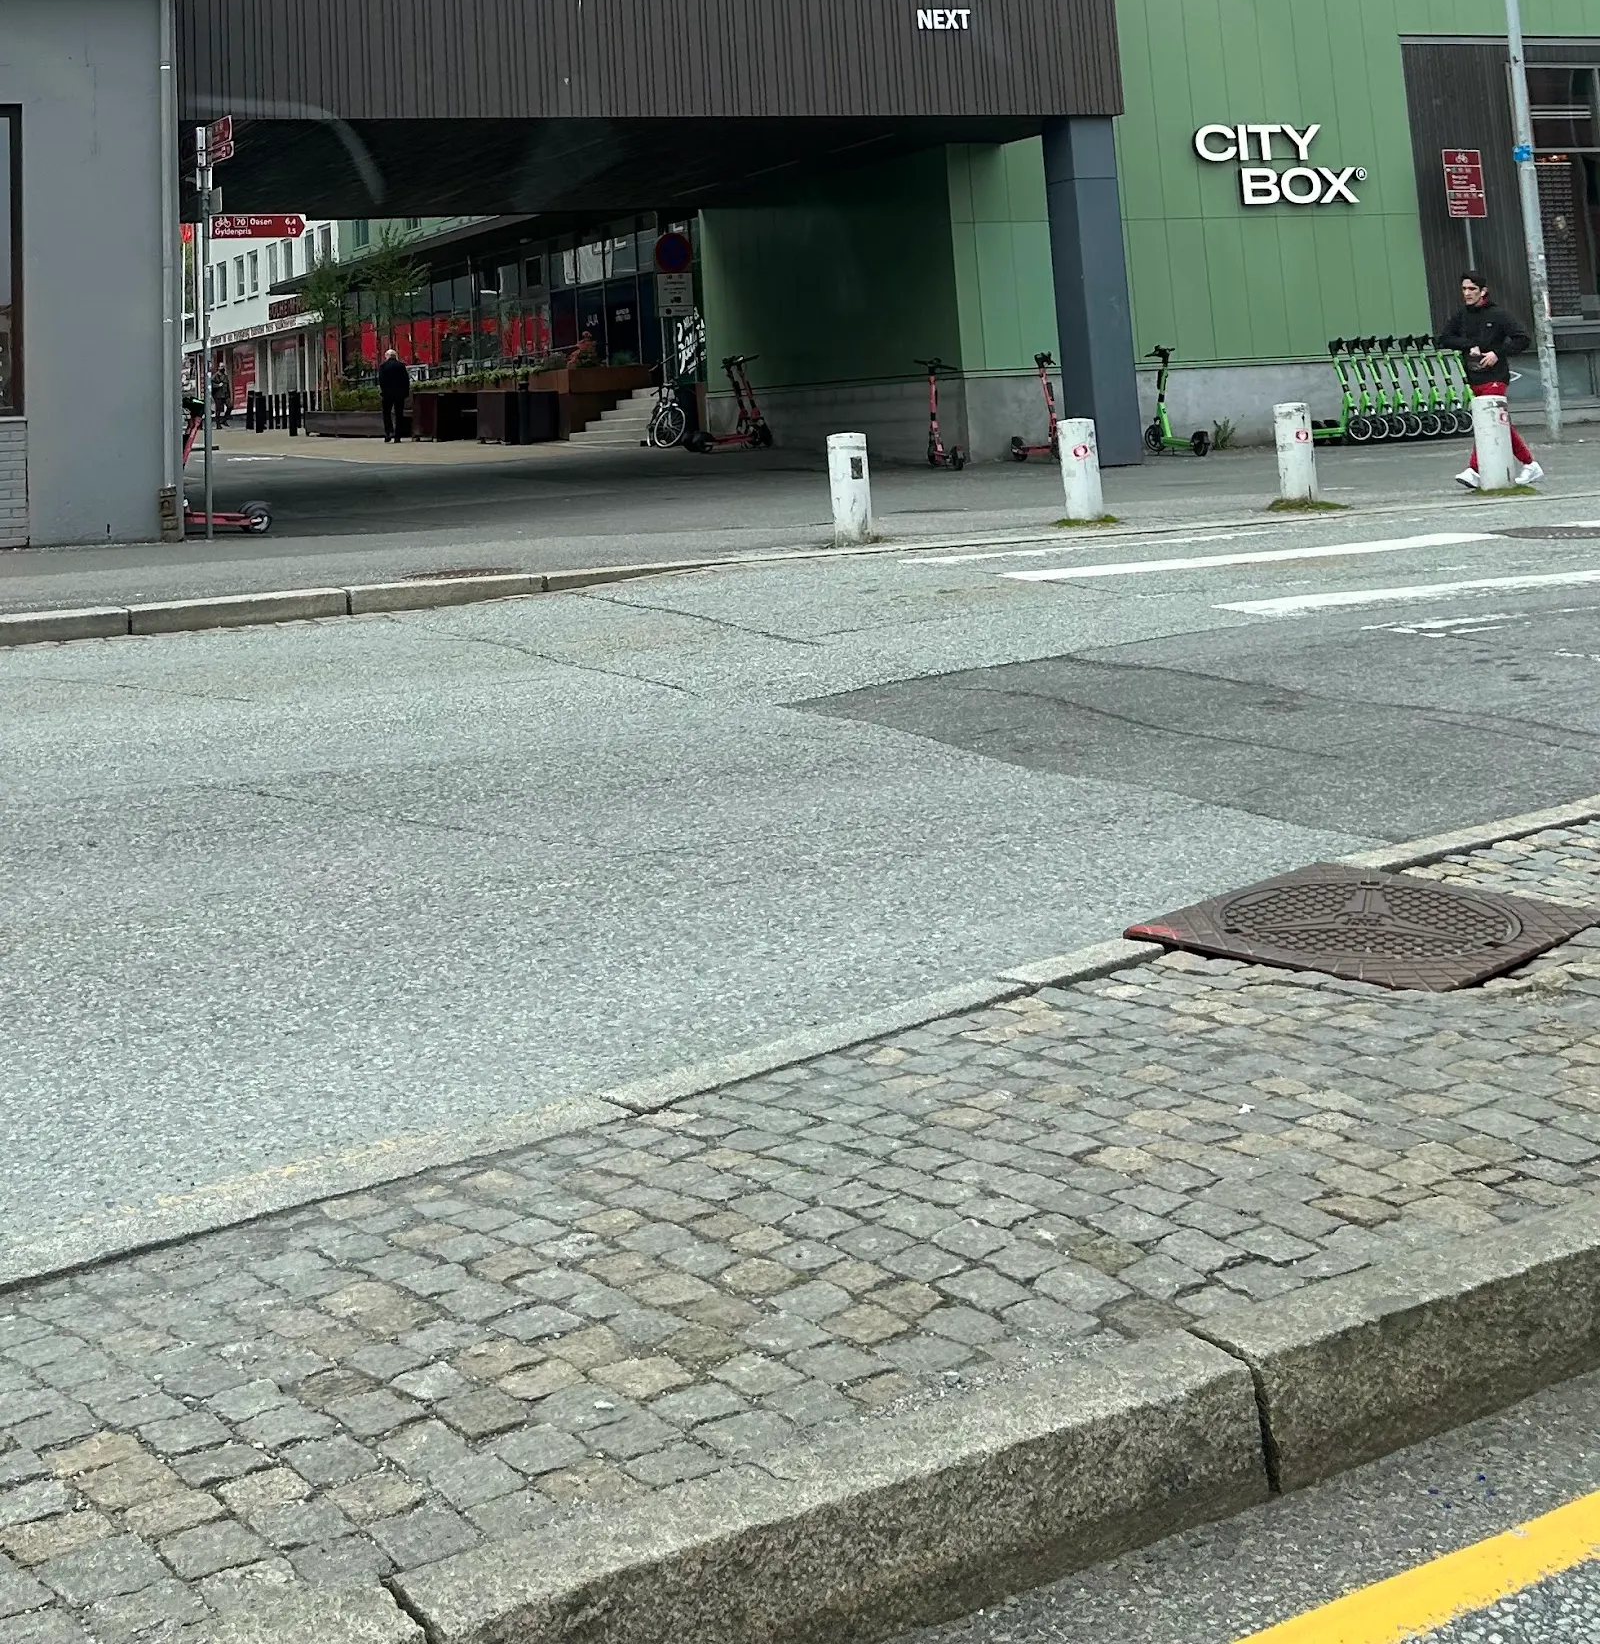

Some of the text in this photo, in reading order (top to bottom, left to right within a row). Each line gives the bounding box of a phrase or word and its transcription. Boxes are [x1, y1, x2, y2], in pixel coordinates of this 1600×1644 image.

[916, 8, 971, 30] NEXT
[1195, 124, 1321, 162] CITY
[236, 218, 246, 226] 70
[214, 228, 252, 236] Gyldenpris
